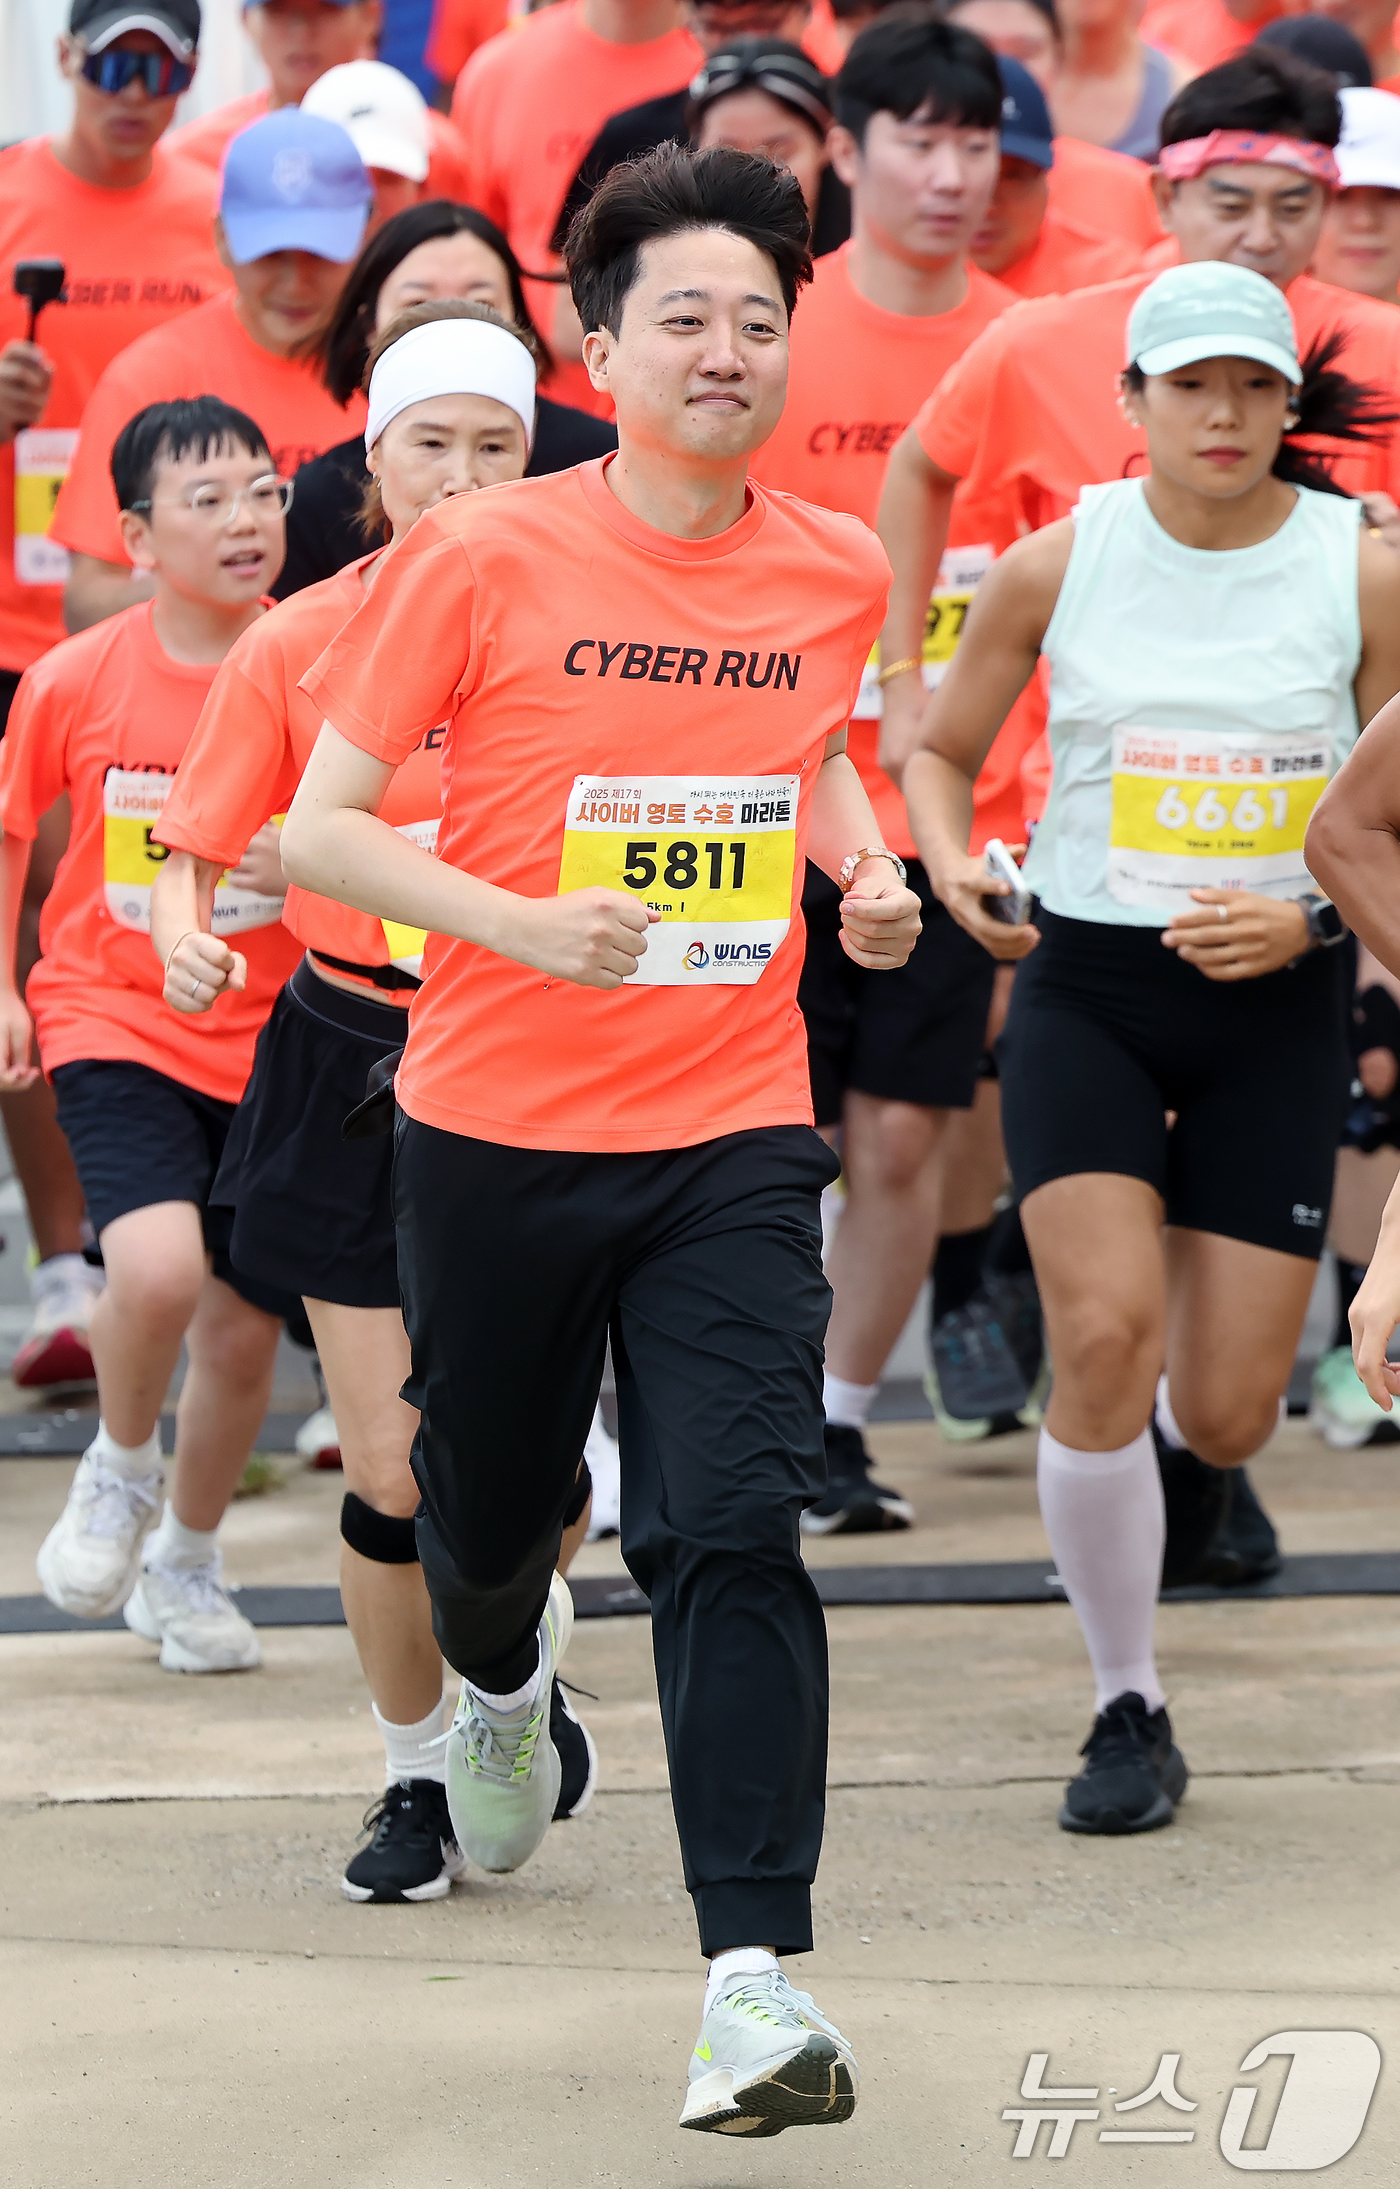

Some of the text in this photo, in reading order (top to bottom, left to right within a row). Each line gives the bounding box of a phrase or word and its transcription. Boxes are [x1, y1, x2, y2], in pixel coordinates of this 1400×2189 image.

[808, 422, 907, 454] CYBE
[563, 639, 802, 691] CYBER RUN
[584, 788, 642, 799] 2025 제17회
[575, 800, 791, 825] 사이버 영토 수호 마라톤
[1154, 784, 1289, 833] 6661
[622, 841, 746, 890] 5811
[646, 902, 673, 912] 5km
[714, 943, 772, 960] WINIS
